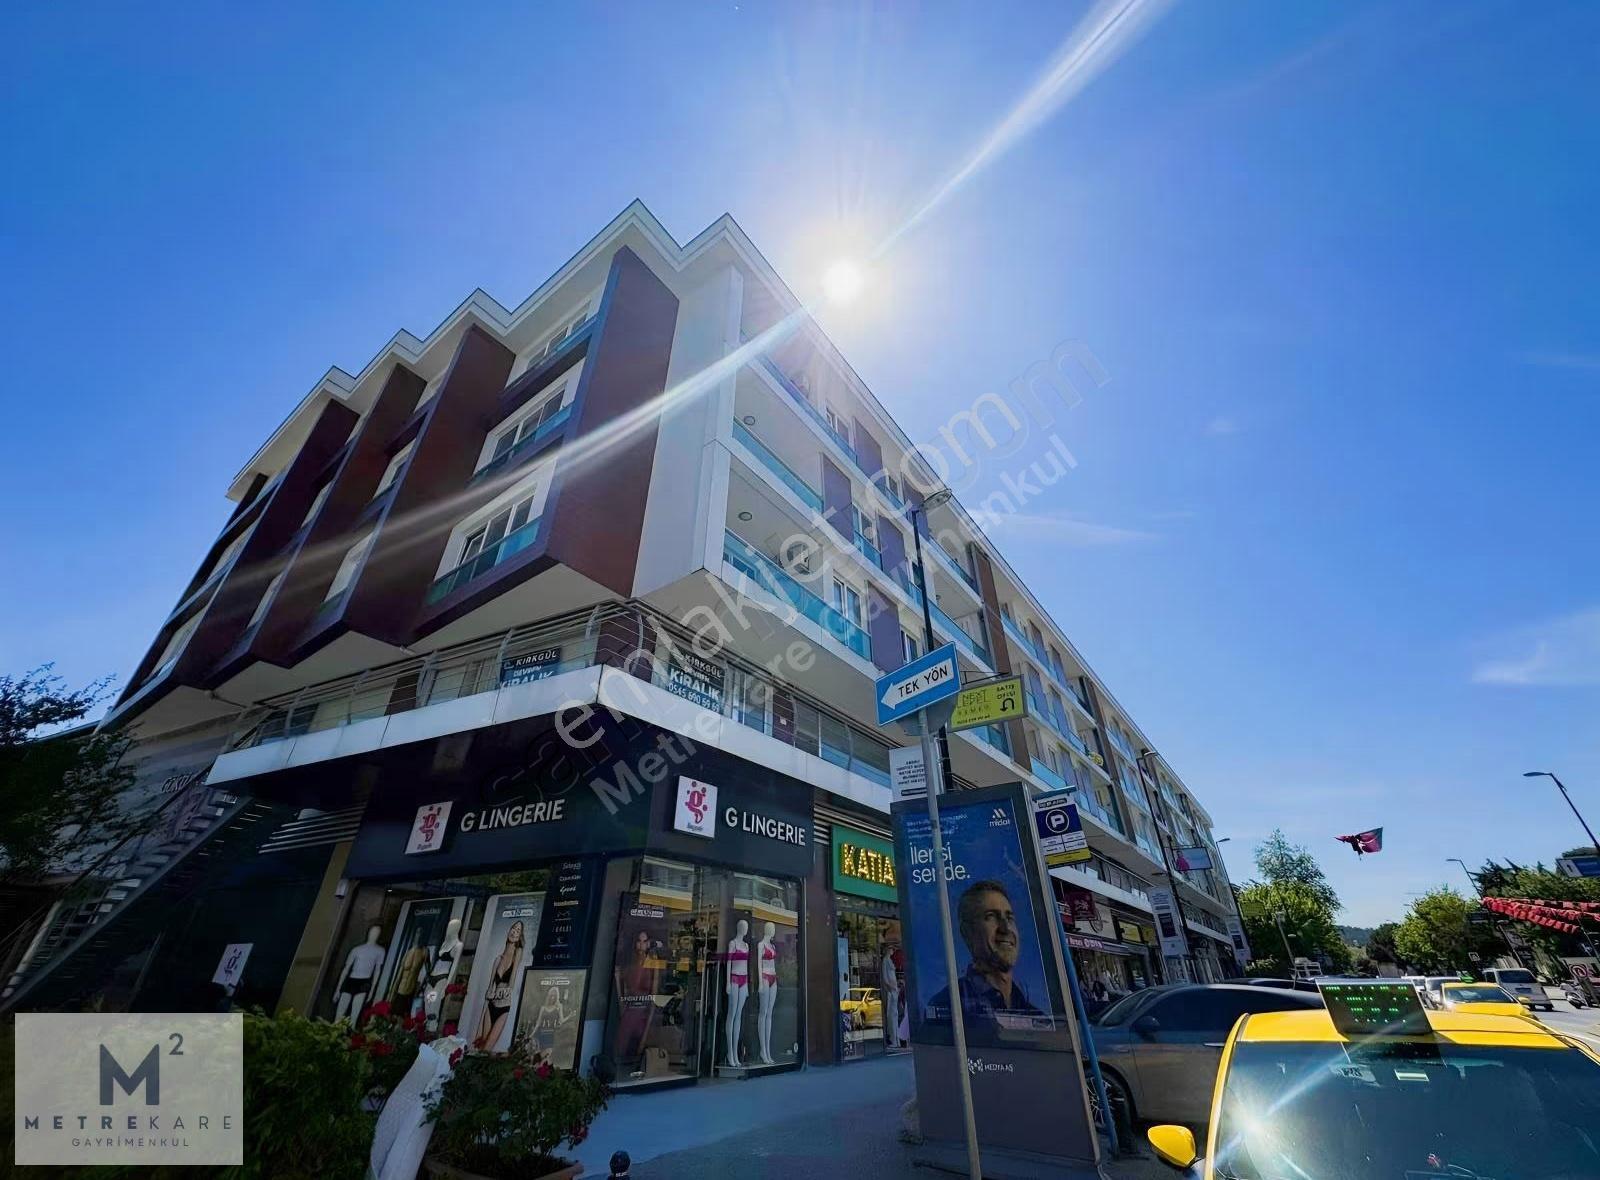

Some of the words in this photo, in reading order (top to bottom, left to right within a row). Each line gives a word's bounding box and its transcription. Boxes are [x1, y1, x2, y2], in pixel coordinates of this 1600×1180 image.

[898, 679, 919, 697] TEK
[924, 665, 948, 684] YÖN
[460, 812, 475, 832] G
[479, 799, 565, 830] LINGERIE
[725, 807, 738, 828] G
[743, 811, 806, 846] LINGERIE
[909, 842, 952, 865] ilersi
